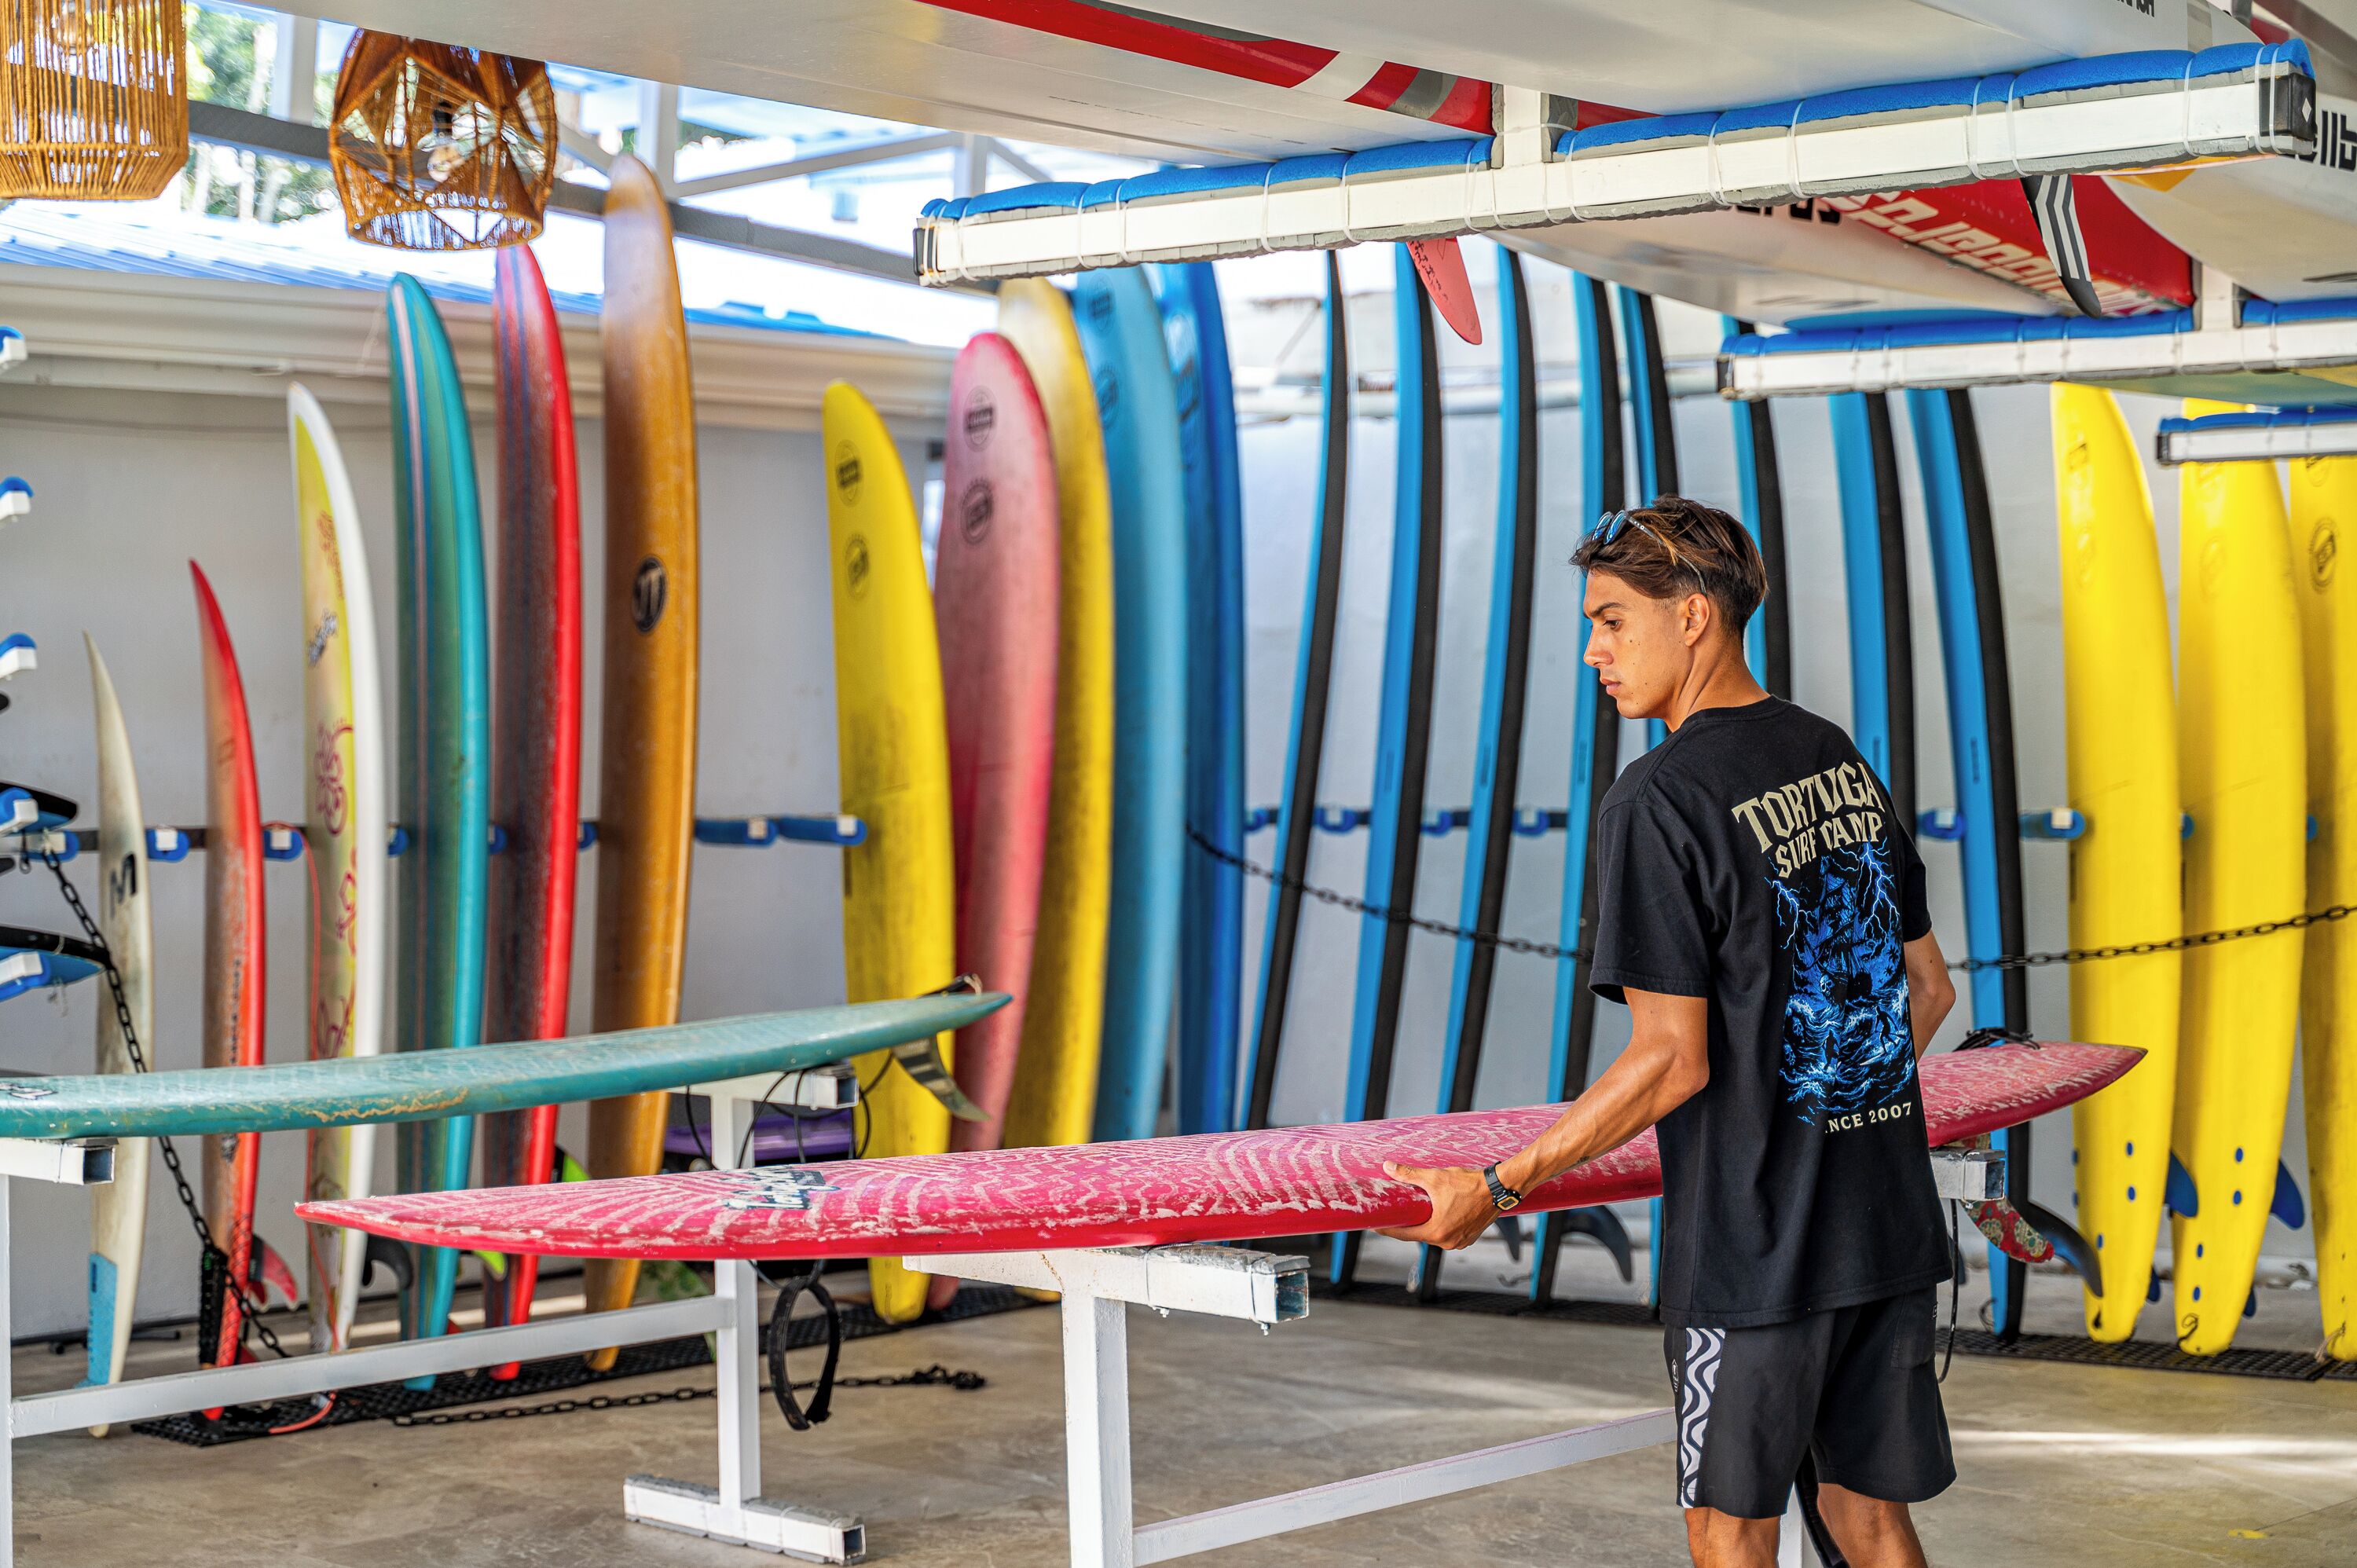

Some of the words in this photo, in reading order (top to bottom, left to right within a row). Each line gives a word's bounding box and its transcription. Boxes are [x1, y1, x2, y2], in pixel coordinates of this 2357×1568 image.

[1731, 761, 1886, 854] TORTUGA
[1775, 826, 1817, 879] SURF
[1819, 811, 1883, 852] CAMP
[1825, 1113, 1864, 1134] NCE
[1868, 1101, 1912, 1123] 2007
